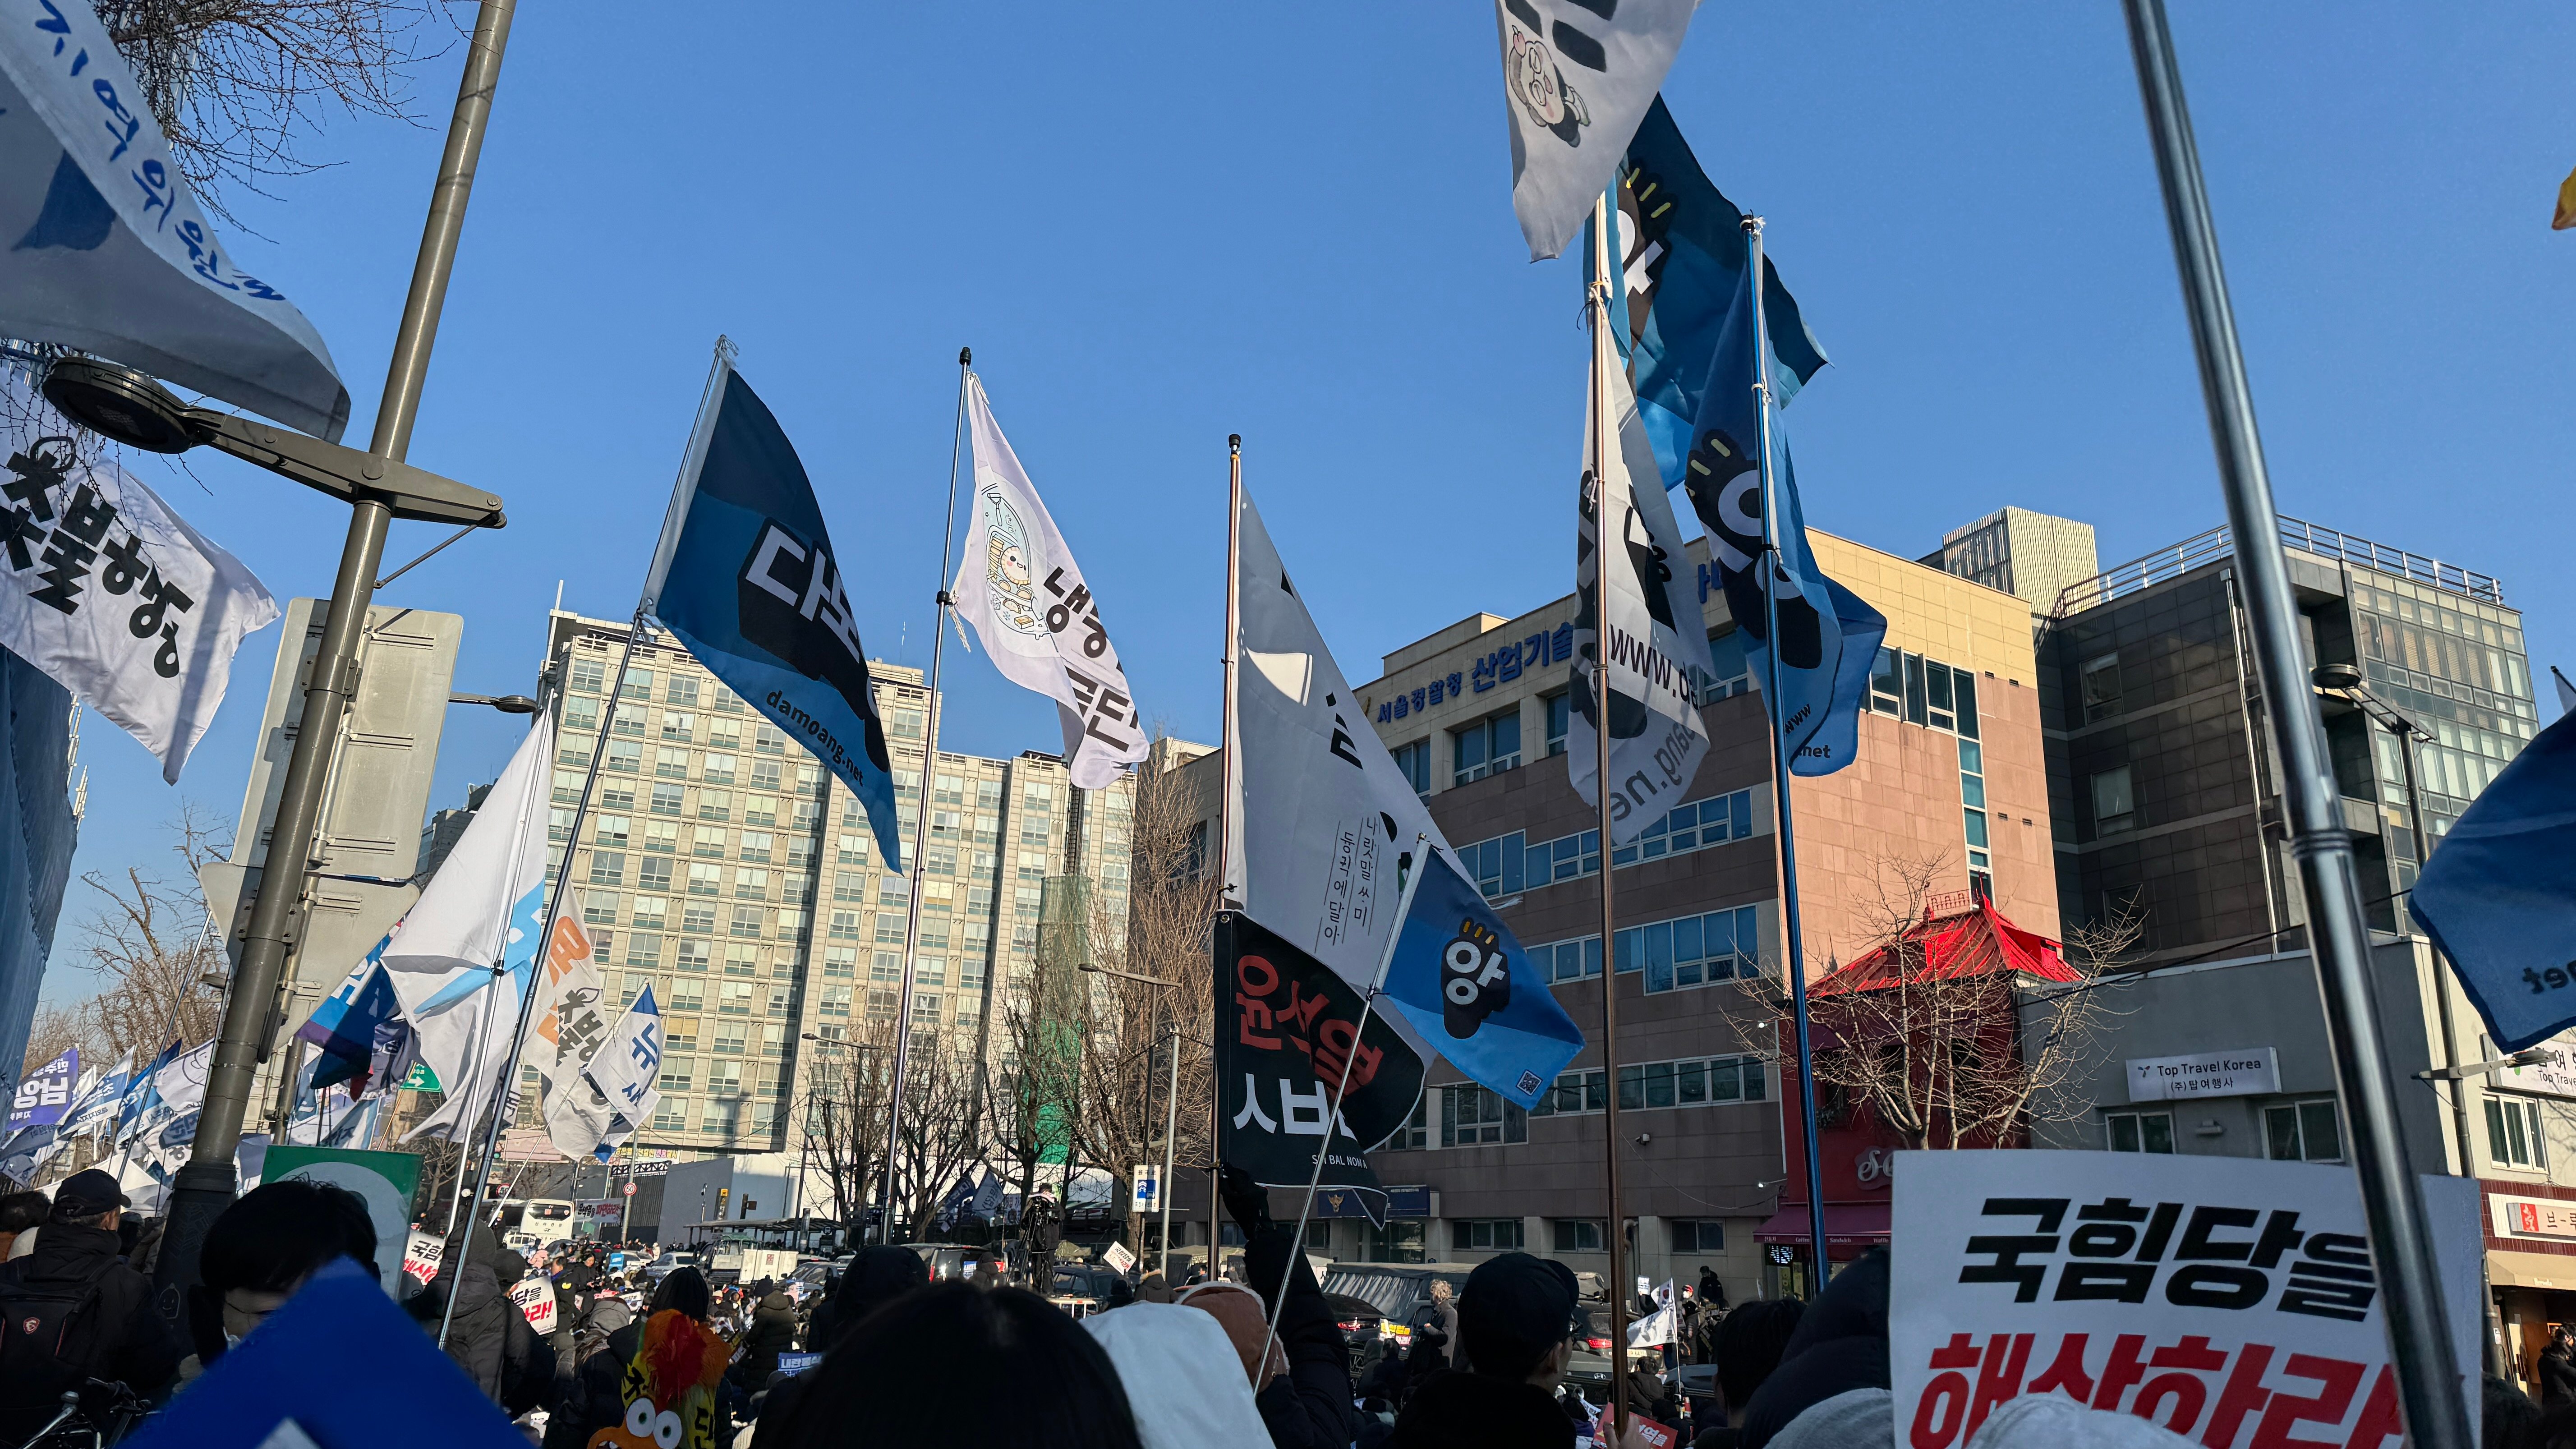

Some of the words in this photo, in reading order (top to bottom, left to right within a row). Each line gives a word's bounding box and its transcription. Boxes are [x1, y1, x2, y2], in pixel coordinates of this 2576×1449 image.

[1377, 672, 1462, 723] 서울경찰청
[766, 690, 865, 787] damoang.net
[1446, 941, 1506, 1006] 앙
[2157, 1066, 2178, 1077] Top
[2181, 1061, 2220, 1075] Travel
[2224, 1060, 2261, 1071] Korea
[2537, 1070, 2553, 1084] Top
[1329, 1155, 1346, 1166] BAL
[1958, 1197, 2376, 1322] 국힘당을
